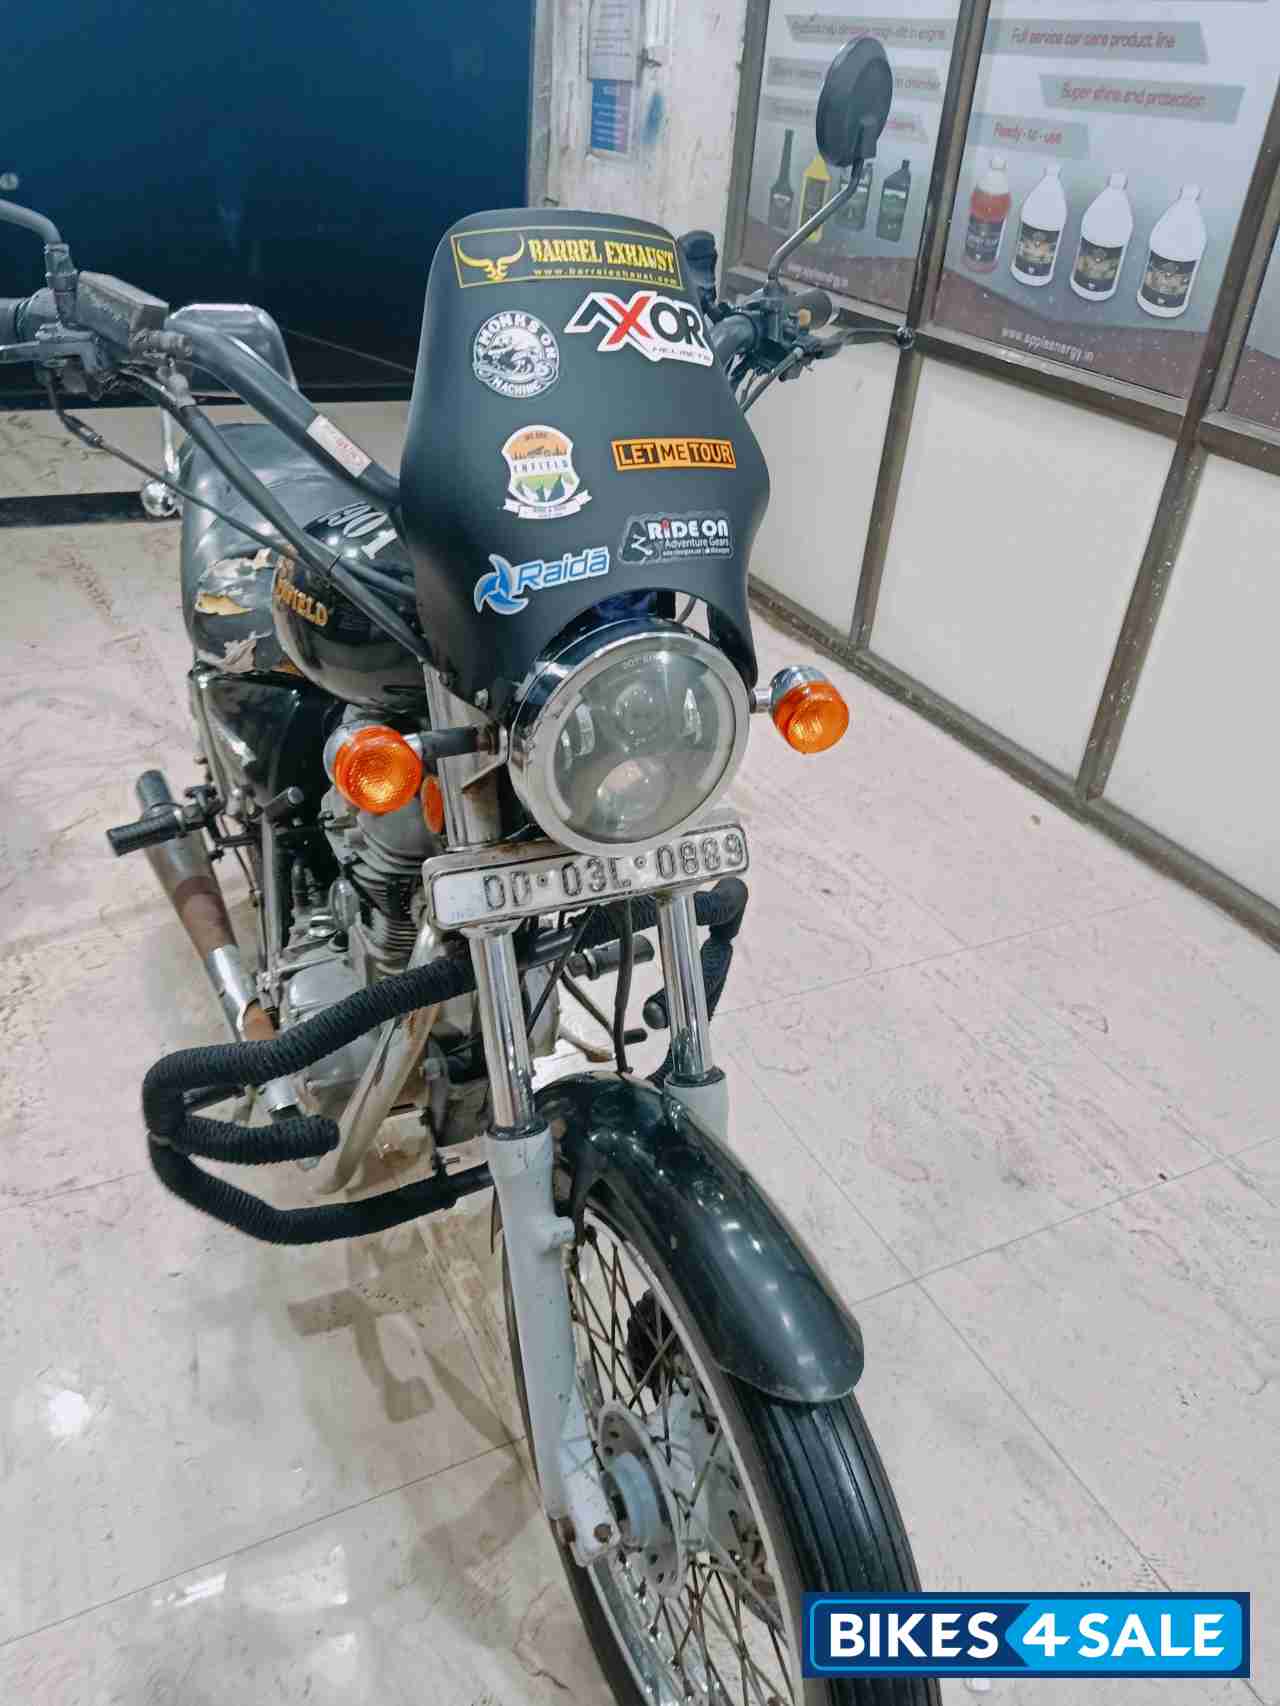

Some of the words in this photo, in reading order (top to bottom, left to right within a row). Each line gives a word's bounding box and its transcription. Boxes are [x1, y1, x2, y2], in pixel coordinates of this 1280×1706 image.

[1109, 31, 1153, 52] product
[1155, 31, 1176, 49] line
[1060, 80, 1093, 106] Super
[1124, 89, 1144, 105] and
[1145, 92, 1206, 109] protection
[529, 239, 602, 264] BARREL
[605, 241, 674, 273] EXHAUST
[570, 294, 706, 348] AXOR
[491, 377, 544, 396] MACHINE
[618, 443, 657, 465] LET
[660, 442, 688, 462] ME
[688, 442, 735, 465] TOUR
[664, 538, 708, 549] Adventure
